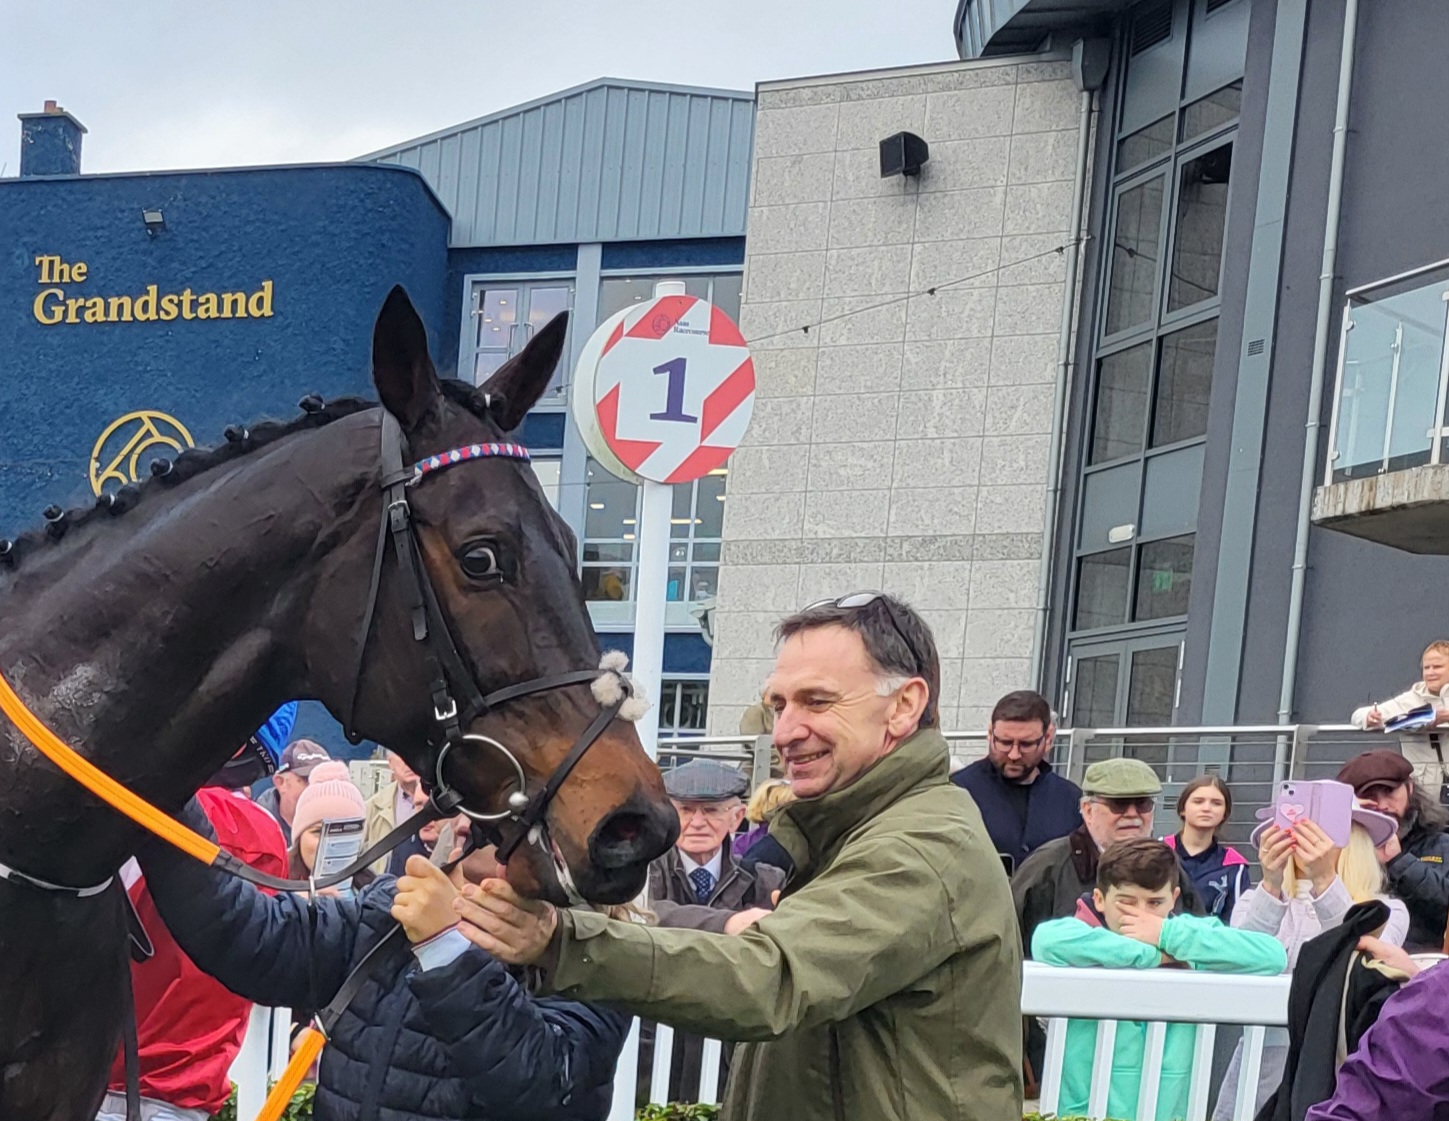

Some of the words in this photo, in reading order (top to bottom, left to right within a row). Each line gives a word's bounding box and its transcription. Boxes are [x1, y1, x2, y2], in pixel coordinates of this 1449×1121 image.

[35, 255, 88, 284] The
[33, 279, 274, 325] Grandstand
[649, 357, 699, 424] 1
